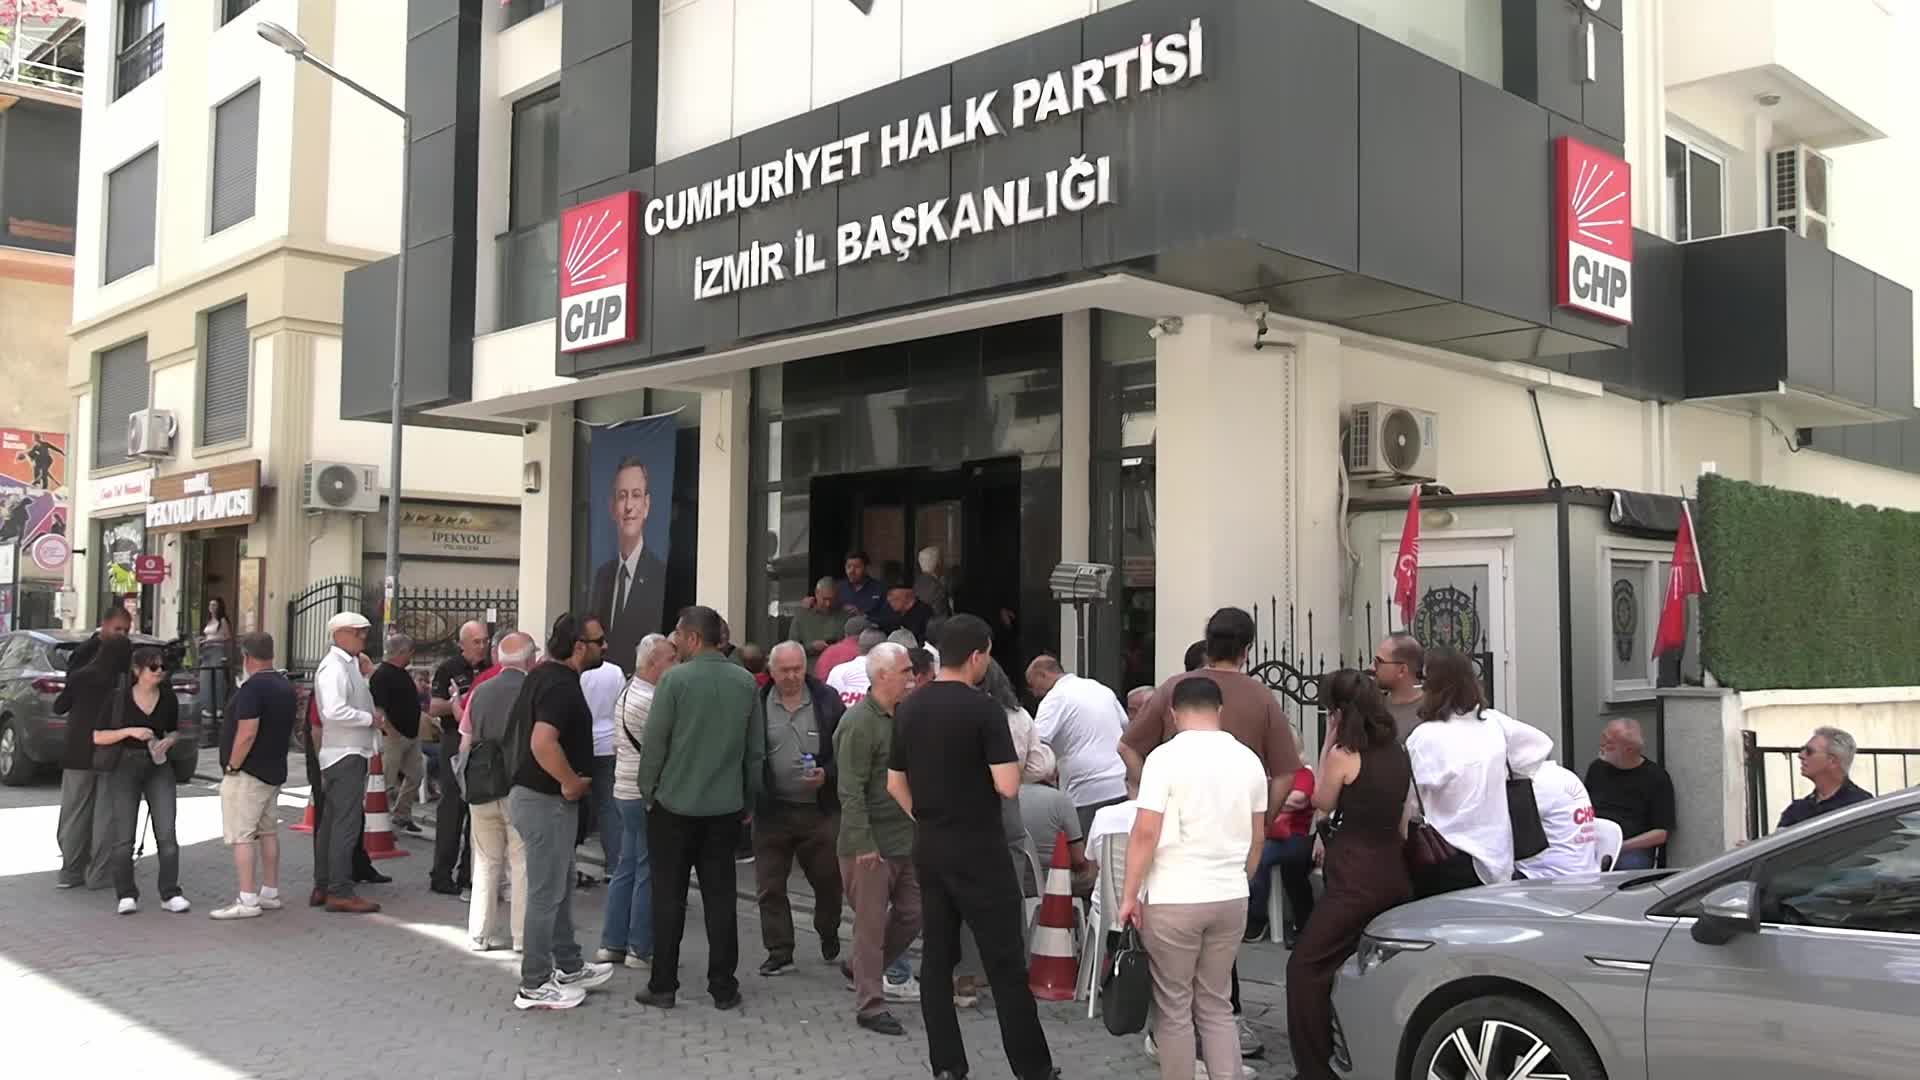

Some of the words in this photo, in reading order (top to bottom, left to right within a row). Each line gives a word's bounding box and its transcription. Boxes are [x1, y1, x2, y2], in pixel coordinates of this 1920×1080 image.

[644, 131, 869, 236] CUMHURİYET
[881, 89, 1000, 168] HALK
[1012, 17, 1203, 128] PARTİSİ
[694, 240, 785, 300] İZMİR
[795, 229, 826, 276] İL
[837, 153, 1110, 266] BAŞKANLIĞI
[564, 294, 622, 343] CHP
[1572, 254, 1627, 309] CHP
